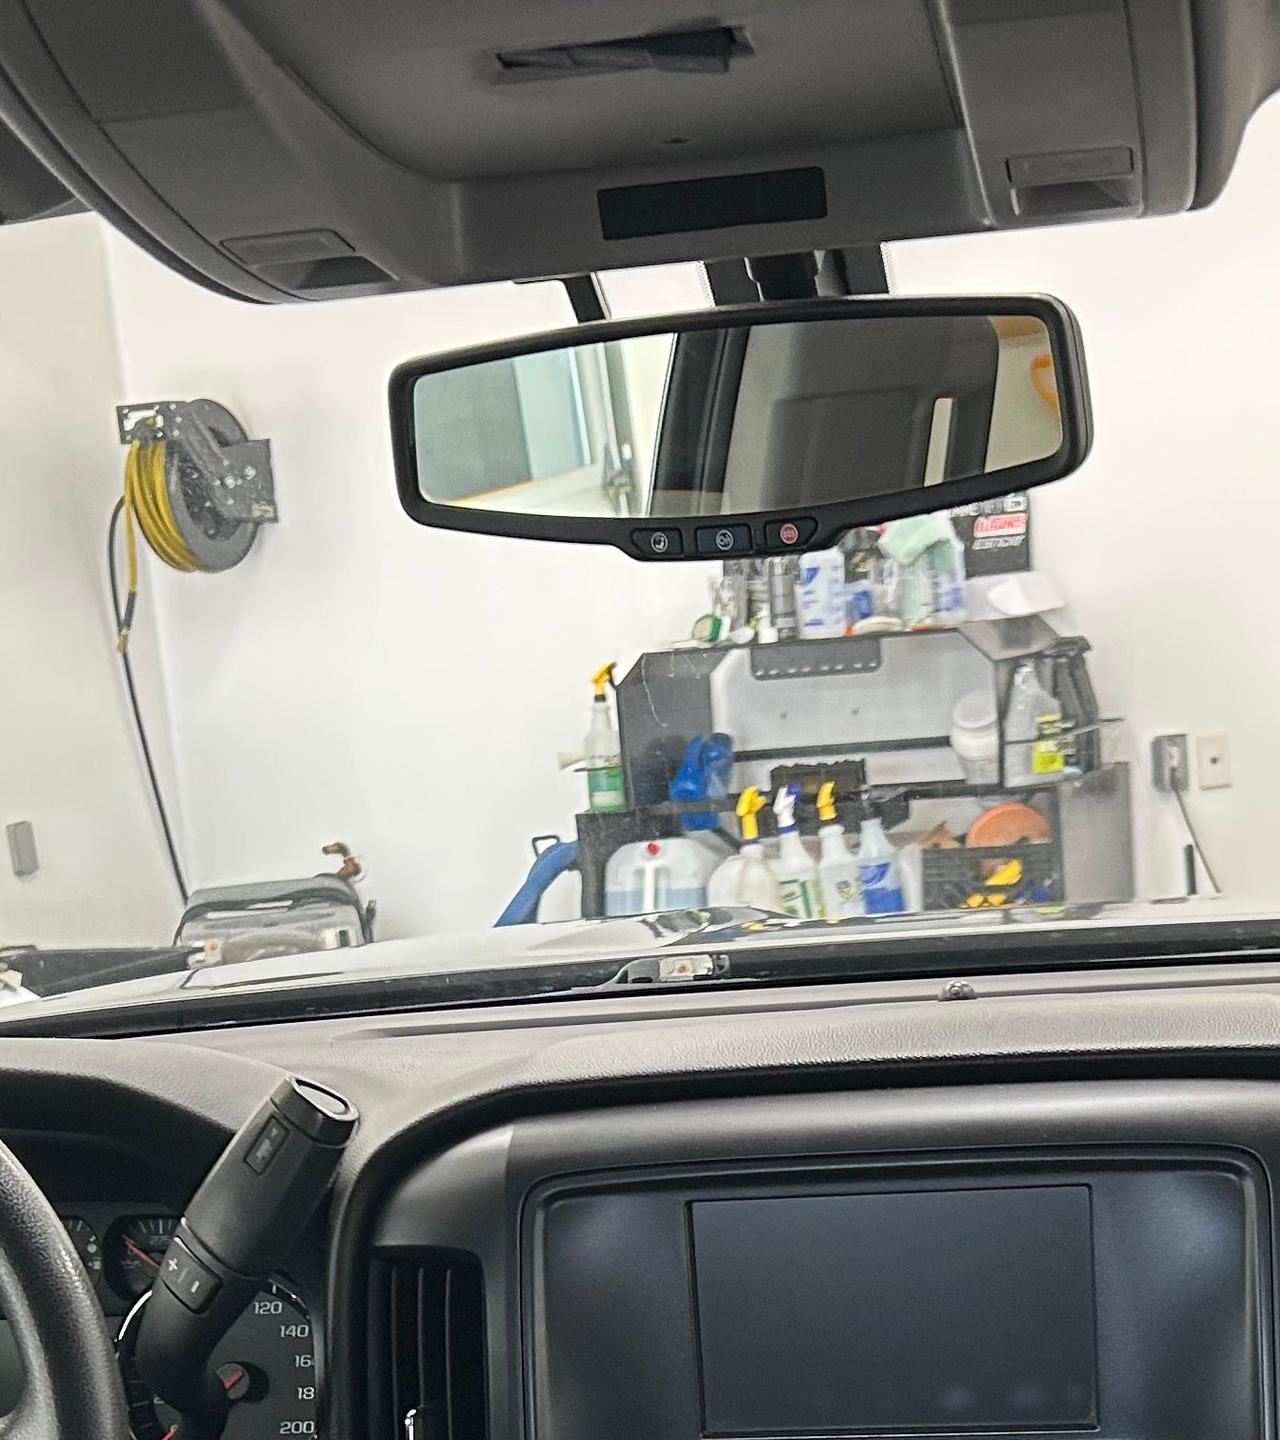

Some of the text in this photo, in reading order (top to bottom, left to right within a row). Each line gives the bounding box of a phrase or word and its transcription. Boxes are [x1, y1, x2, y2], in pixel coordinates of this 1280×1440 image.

[254, 1301, 283, 1314] 120
[280, 1325, 309, 1338] 140
[295, 1355, 315, 1368] 16
[297, 1386, 316, 1400] 18
[279, 1421, 315, 1435] 200
